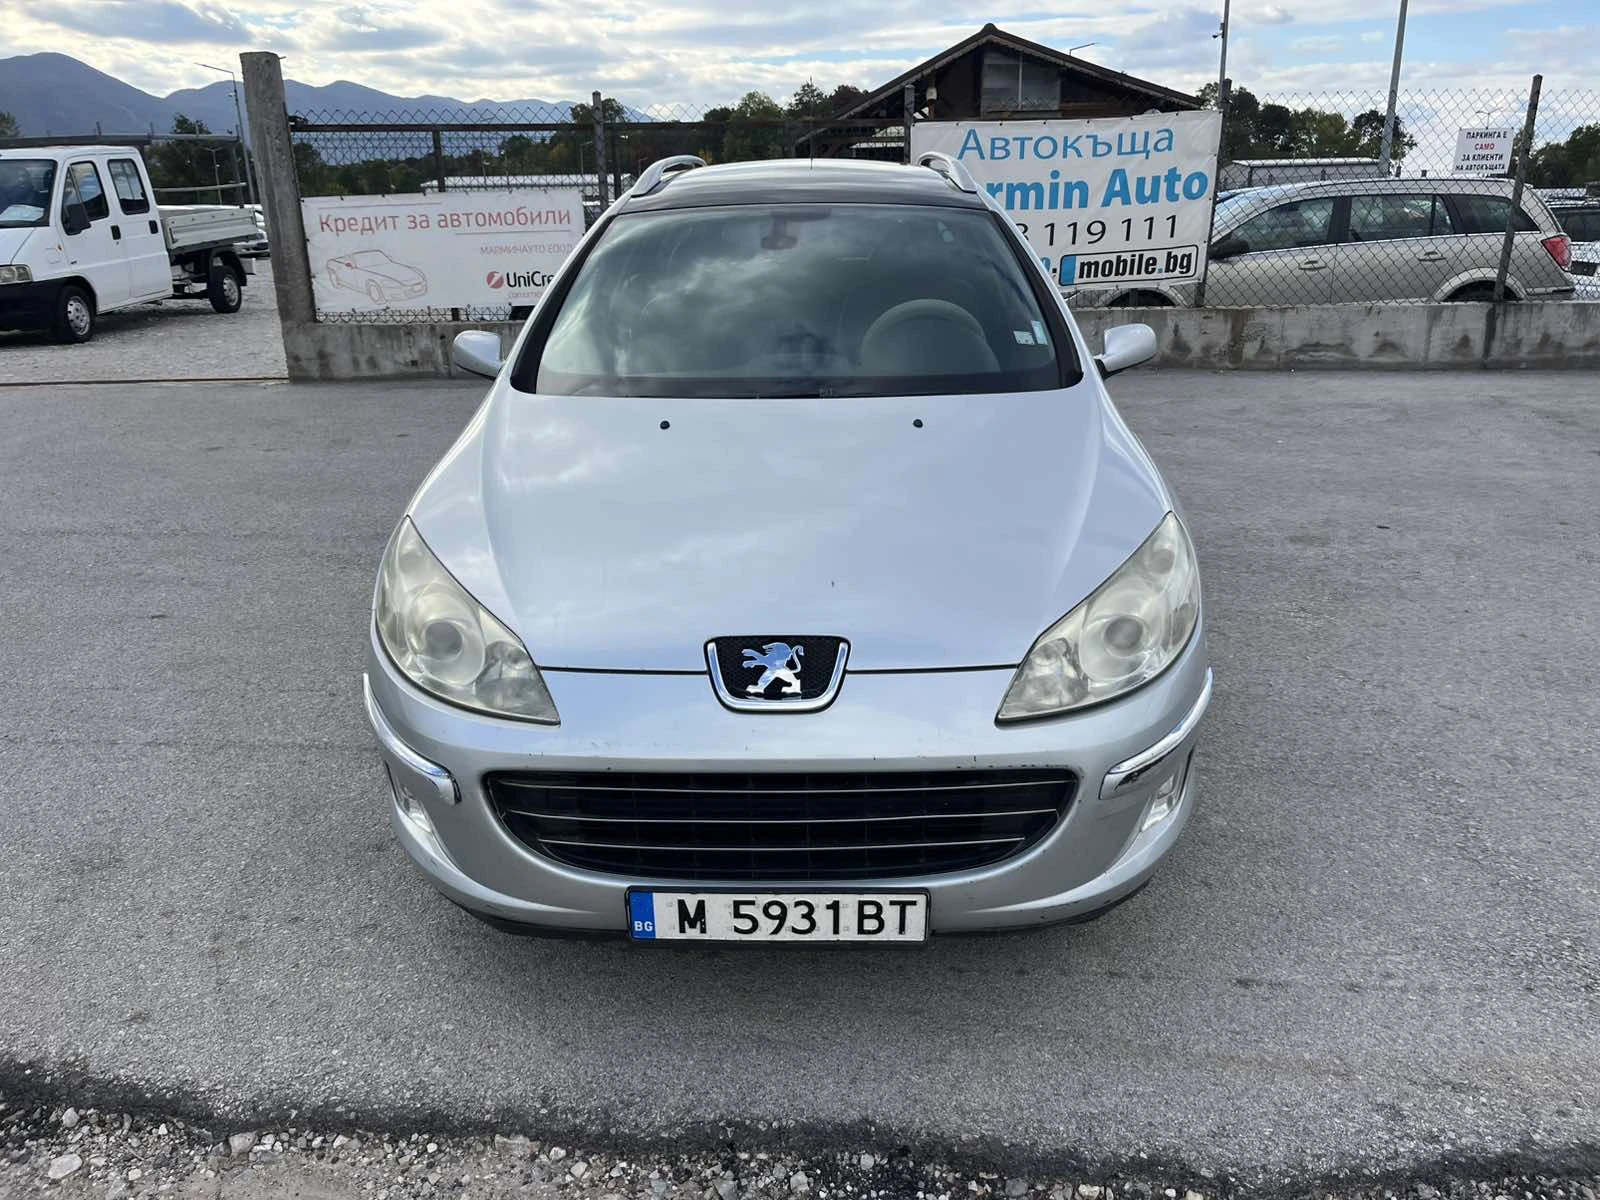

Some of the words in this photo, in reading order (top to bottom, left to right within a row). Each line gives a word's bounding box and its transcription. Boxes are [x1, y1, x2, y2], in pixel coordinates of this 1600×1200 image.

[957, 128, 1174, 160] Автокъща
[1466, 131, 1501, 139] ПАРКИНГА
[1502, 131, 1508, 139] Е
[1461, 154, 1470, 162] ЗА
[1472, 153, 1504, 161] КЛИЕНТИ
[1101, 167, 1209, 208] Auto
[320, 214, 400, 237] Кредит
[407, 214, 430, 230] за
[438, 206, 572, 229] автомобили
[1044, 219, 1107, 248] 119
[1121, 214, 1177, 242] 111
[1078, 251, 1193, 279] mobile.bg
[634, 920, 653, 932] BG
[677, 898, 707, 934] M
[732, 899, 840, 935] 5931
[857, 899, 917, 935] BT
